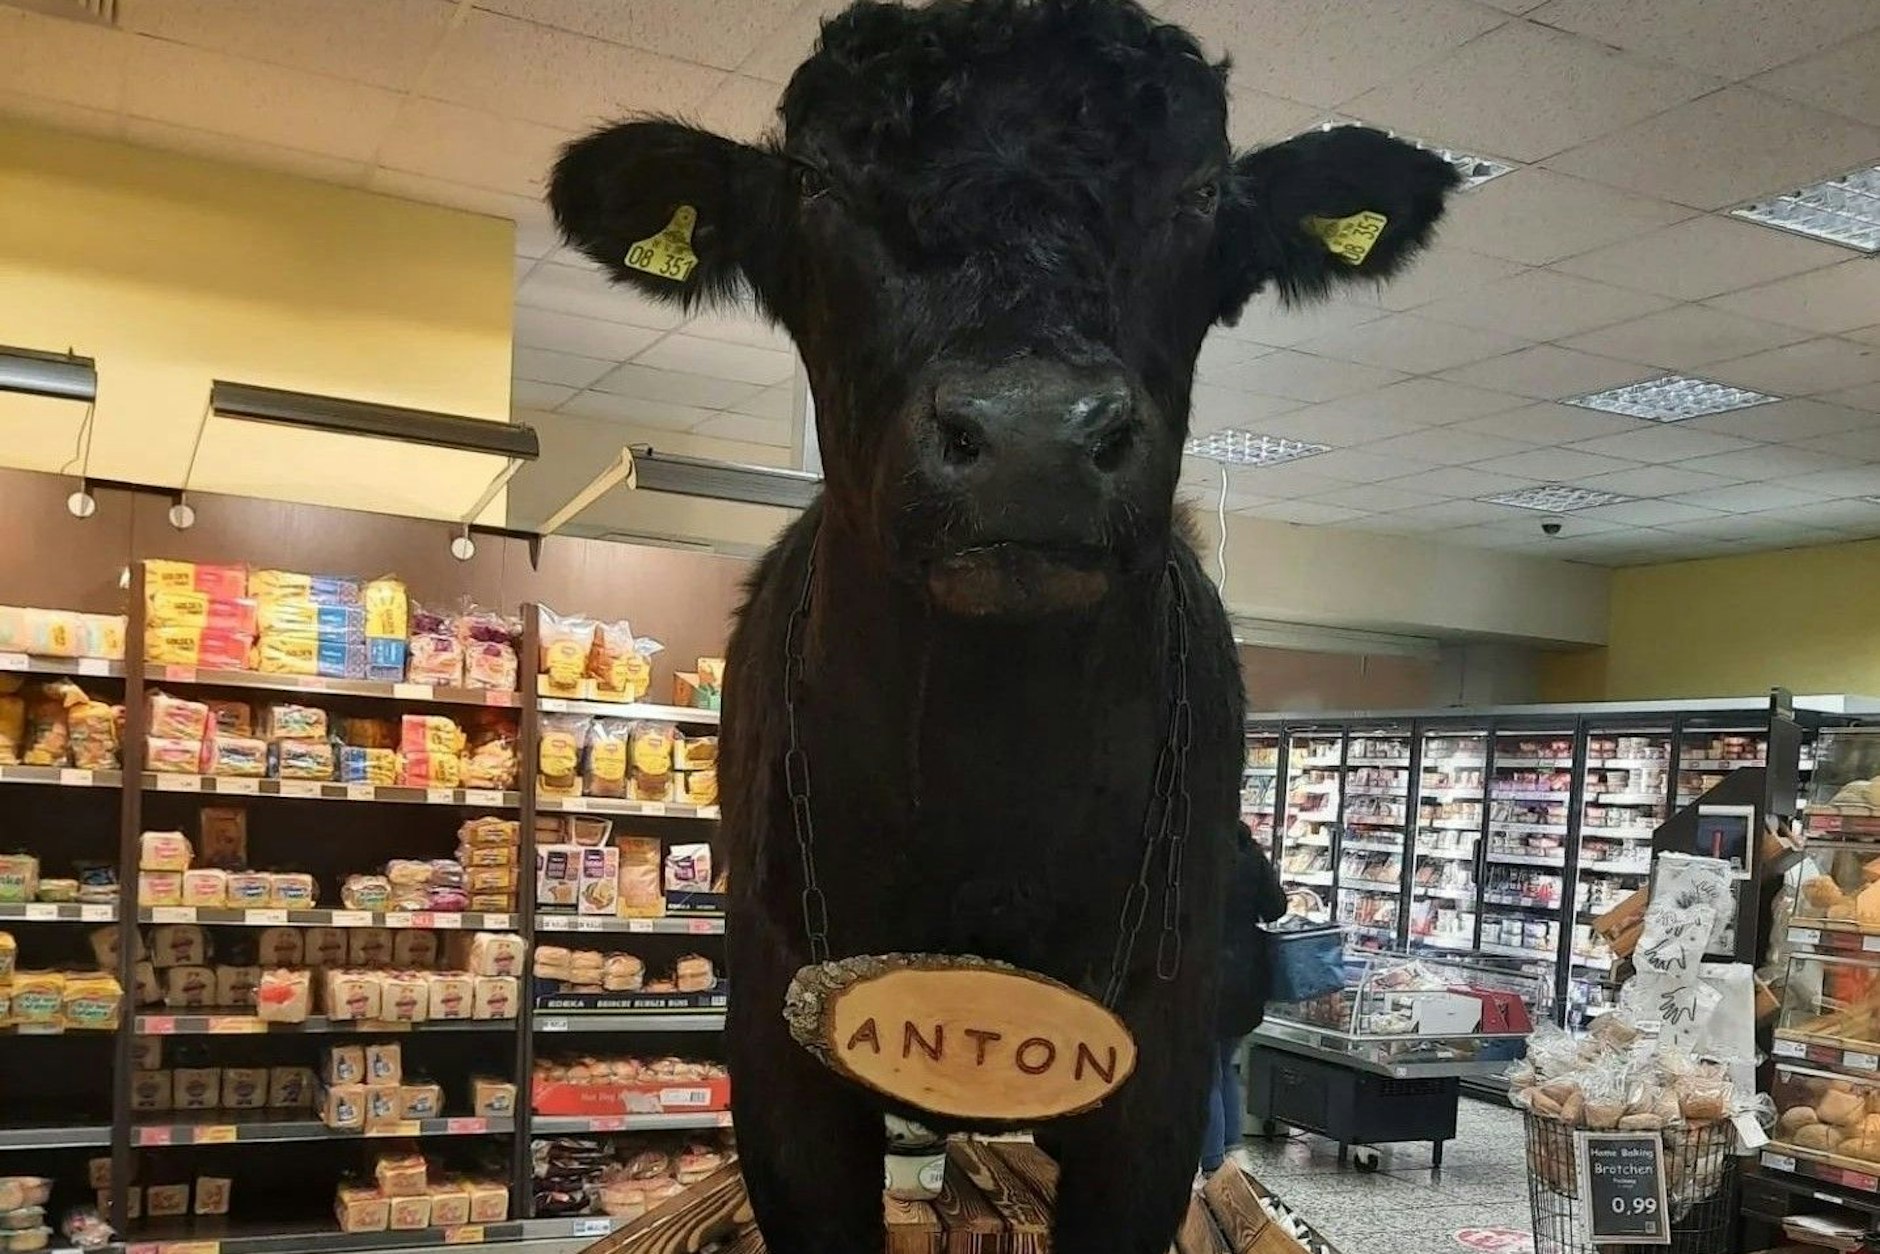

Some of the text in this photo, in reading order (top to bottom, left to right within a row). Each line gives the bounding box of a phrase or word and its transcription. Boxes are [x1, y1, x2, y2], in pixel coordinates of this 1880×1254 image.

[628, 245, 693, 279] 08 351
[848, 1018, 1117, 1084] ANTON
[1590, 1148, 1654, 1158] Home Baking
